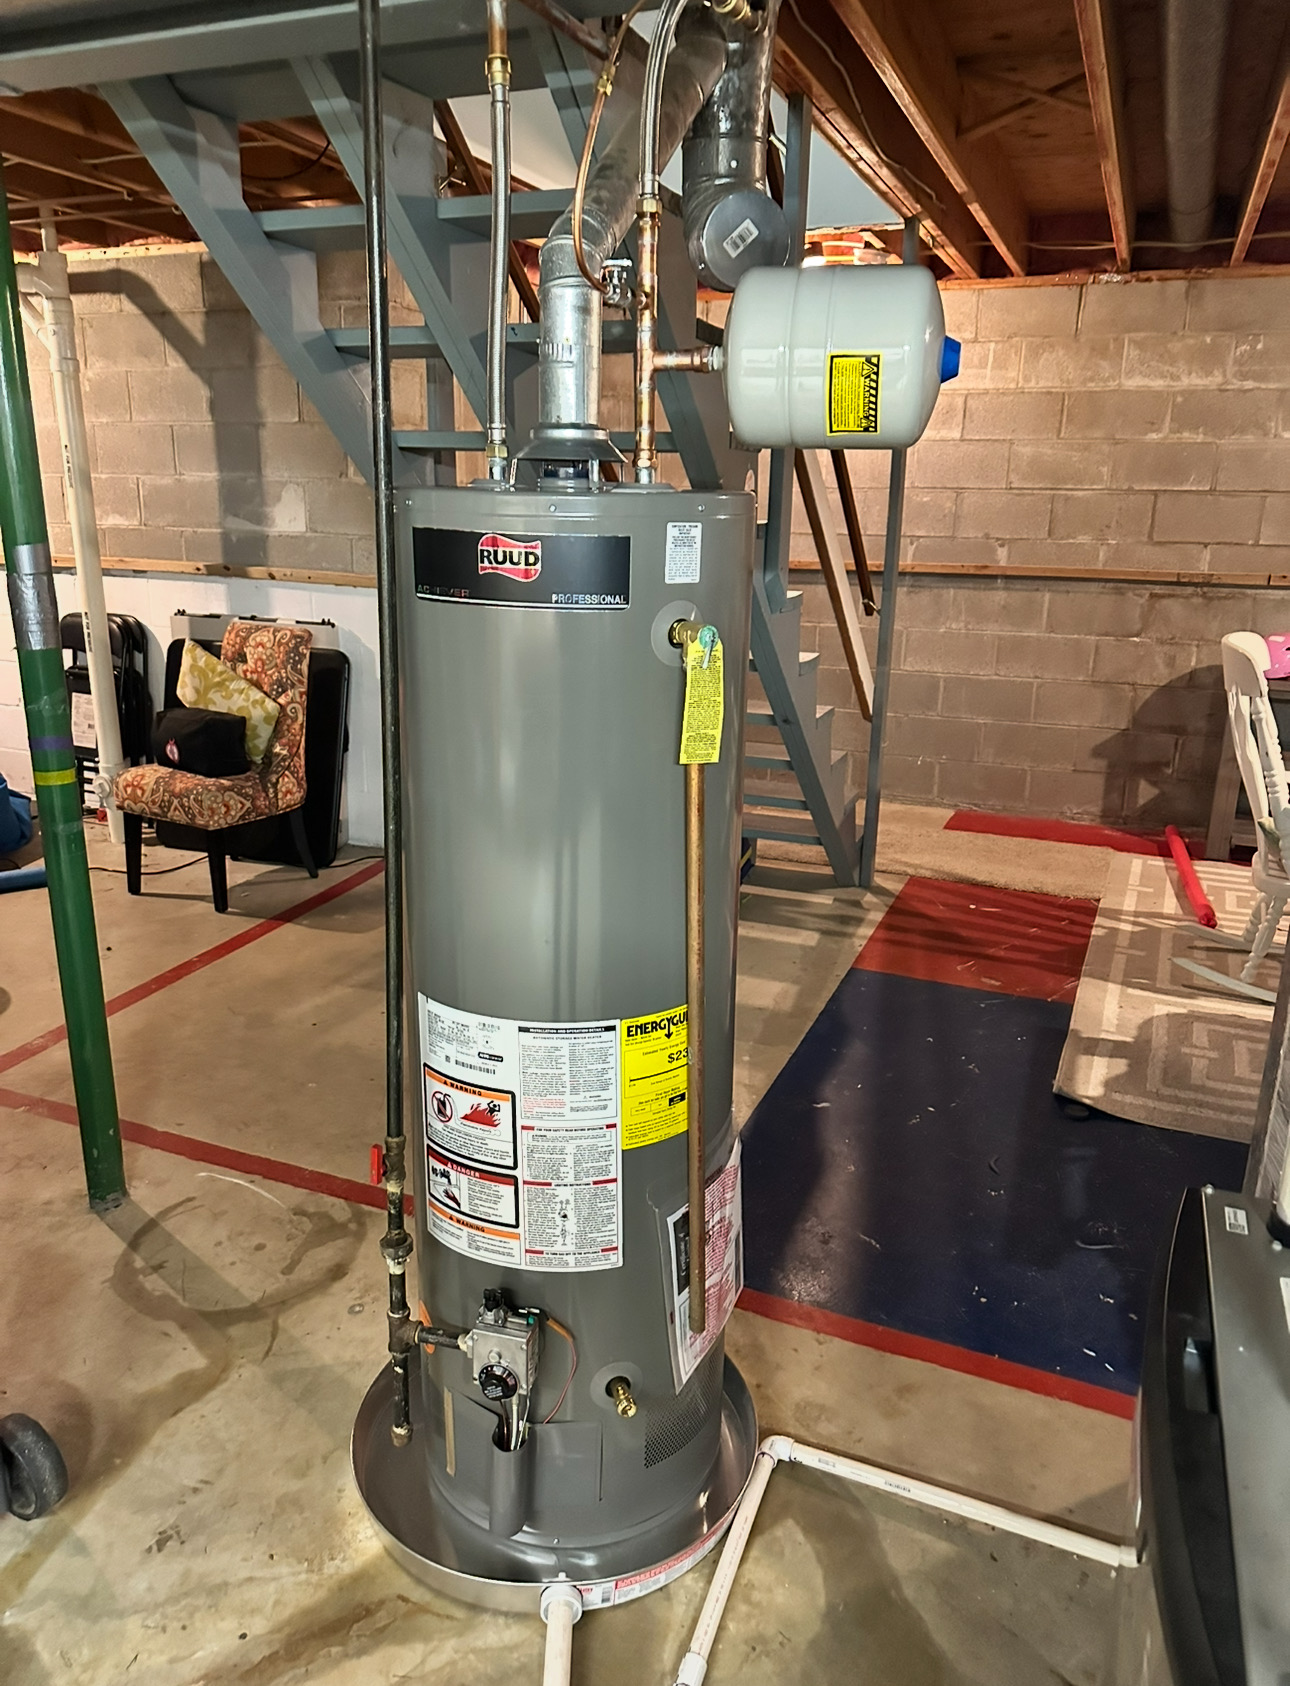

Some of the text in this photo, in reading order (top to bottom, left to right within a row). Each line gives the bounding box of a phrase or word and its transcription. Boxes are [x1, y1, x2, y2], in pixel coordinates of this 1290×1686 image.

[863, 378, 871, 417] WARNING
[480, 549, 540, 566] RUUD
[551, 593, 627, 604] PROFESSIONAL
[450, 1081, 482, 1097] WARNING
[453, 1164, 480, 1178] DANGER
[456, 1217, 485, 1233] WARNING
